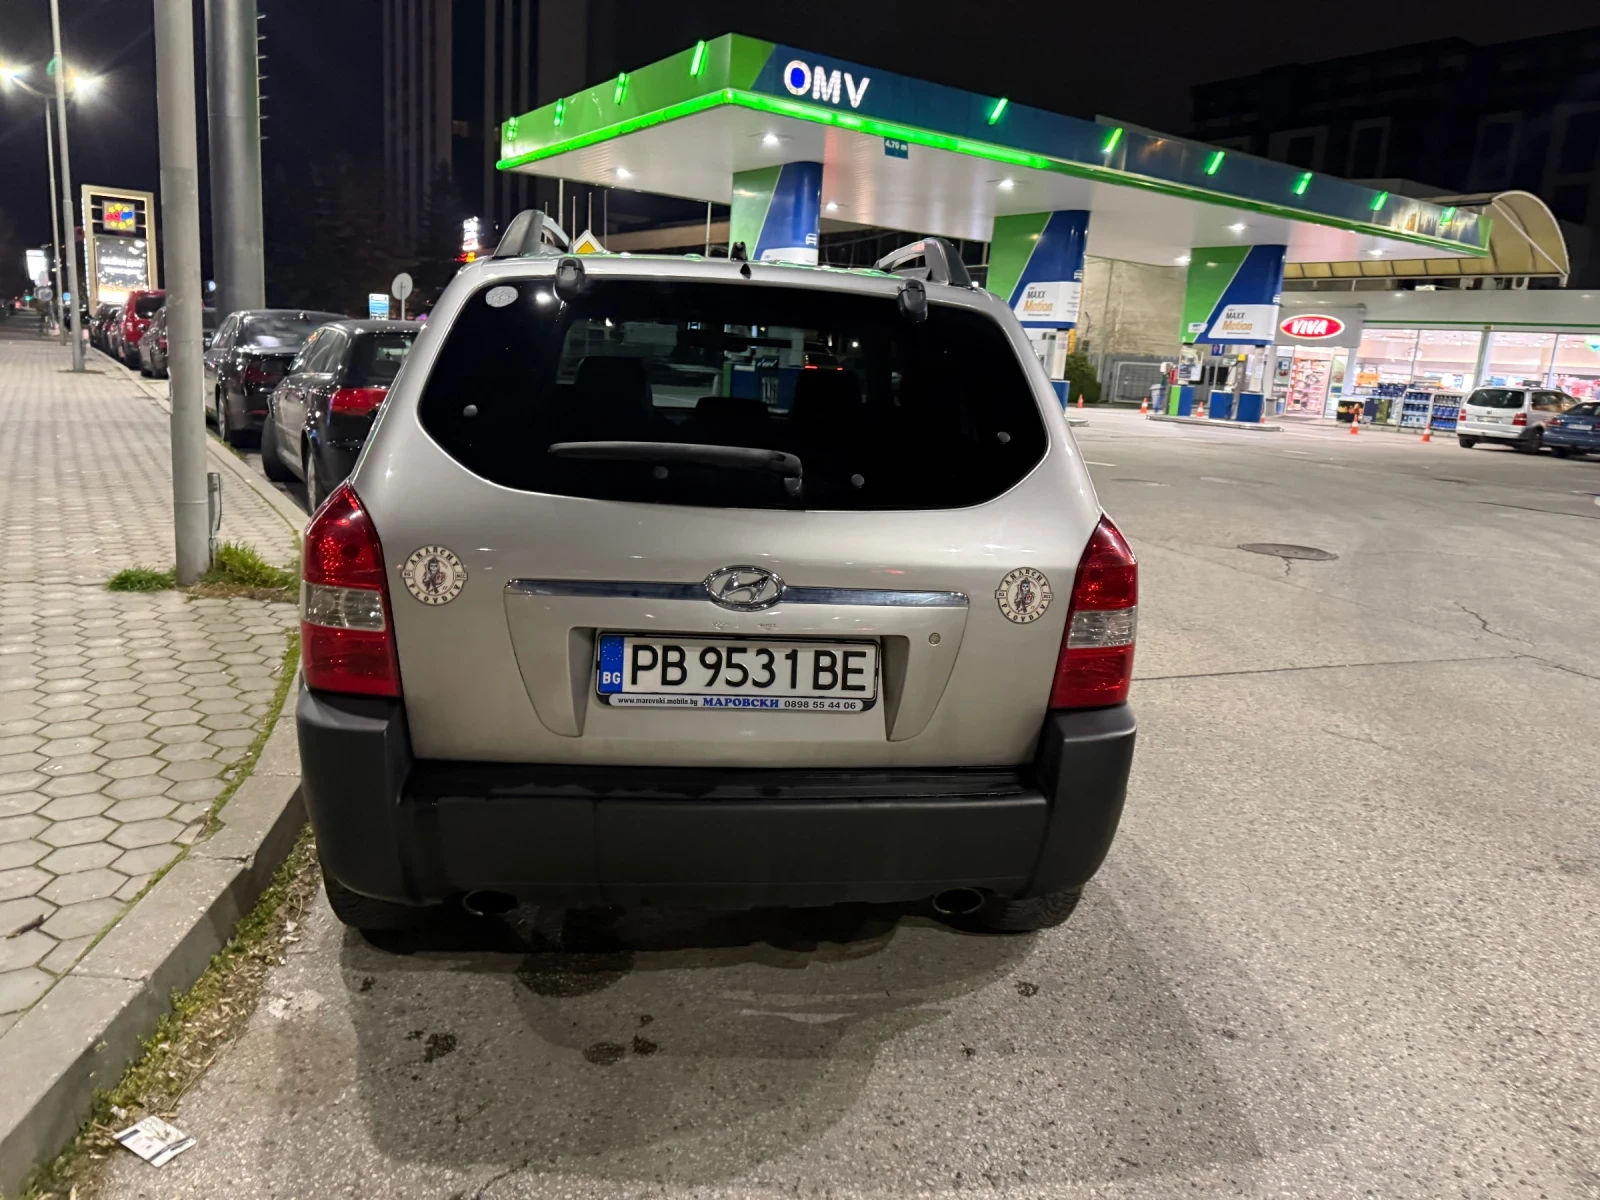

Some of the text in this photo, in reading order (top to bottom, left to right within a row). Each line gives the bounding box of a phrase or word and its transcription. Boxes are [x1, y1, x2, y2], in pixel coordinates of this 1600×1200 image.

[784, 60, 870, 108] OMV
[1026, 291, 1046, 299] MAXX
[1023, 299, 1054, 312] Motion
[1225, 312, 1246, 320] MAXX
[1222, 320, 1253, 331] Motion
[1291, 319, 1328, 335] VIVA
[409, 546, 459, 567] ANARCHY
[1005, 569, 1047, 587] ANARCHY
[409, 583, 461, 604] PLOVDIV
[1002, 603, 1046, 622] PLOVDIV
[631, 644, 867, 692] PB 9531 BE
[602, 671, 621, 685] BG
[618, 697, 698, 706] www.marovski.mobile.bg
[702, 697, 779, 708] МАРОВСКИ
[784, 701, 809, 709] 0898
[828, 702, 841, 710] 44
[844, 702, 856, 710] 06
